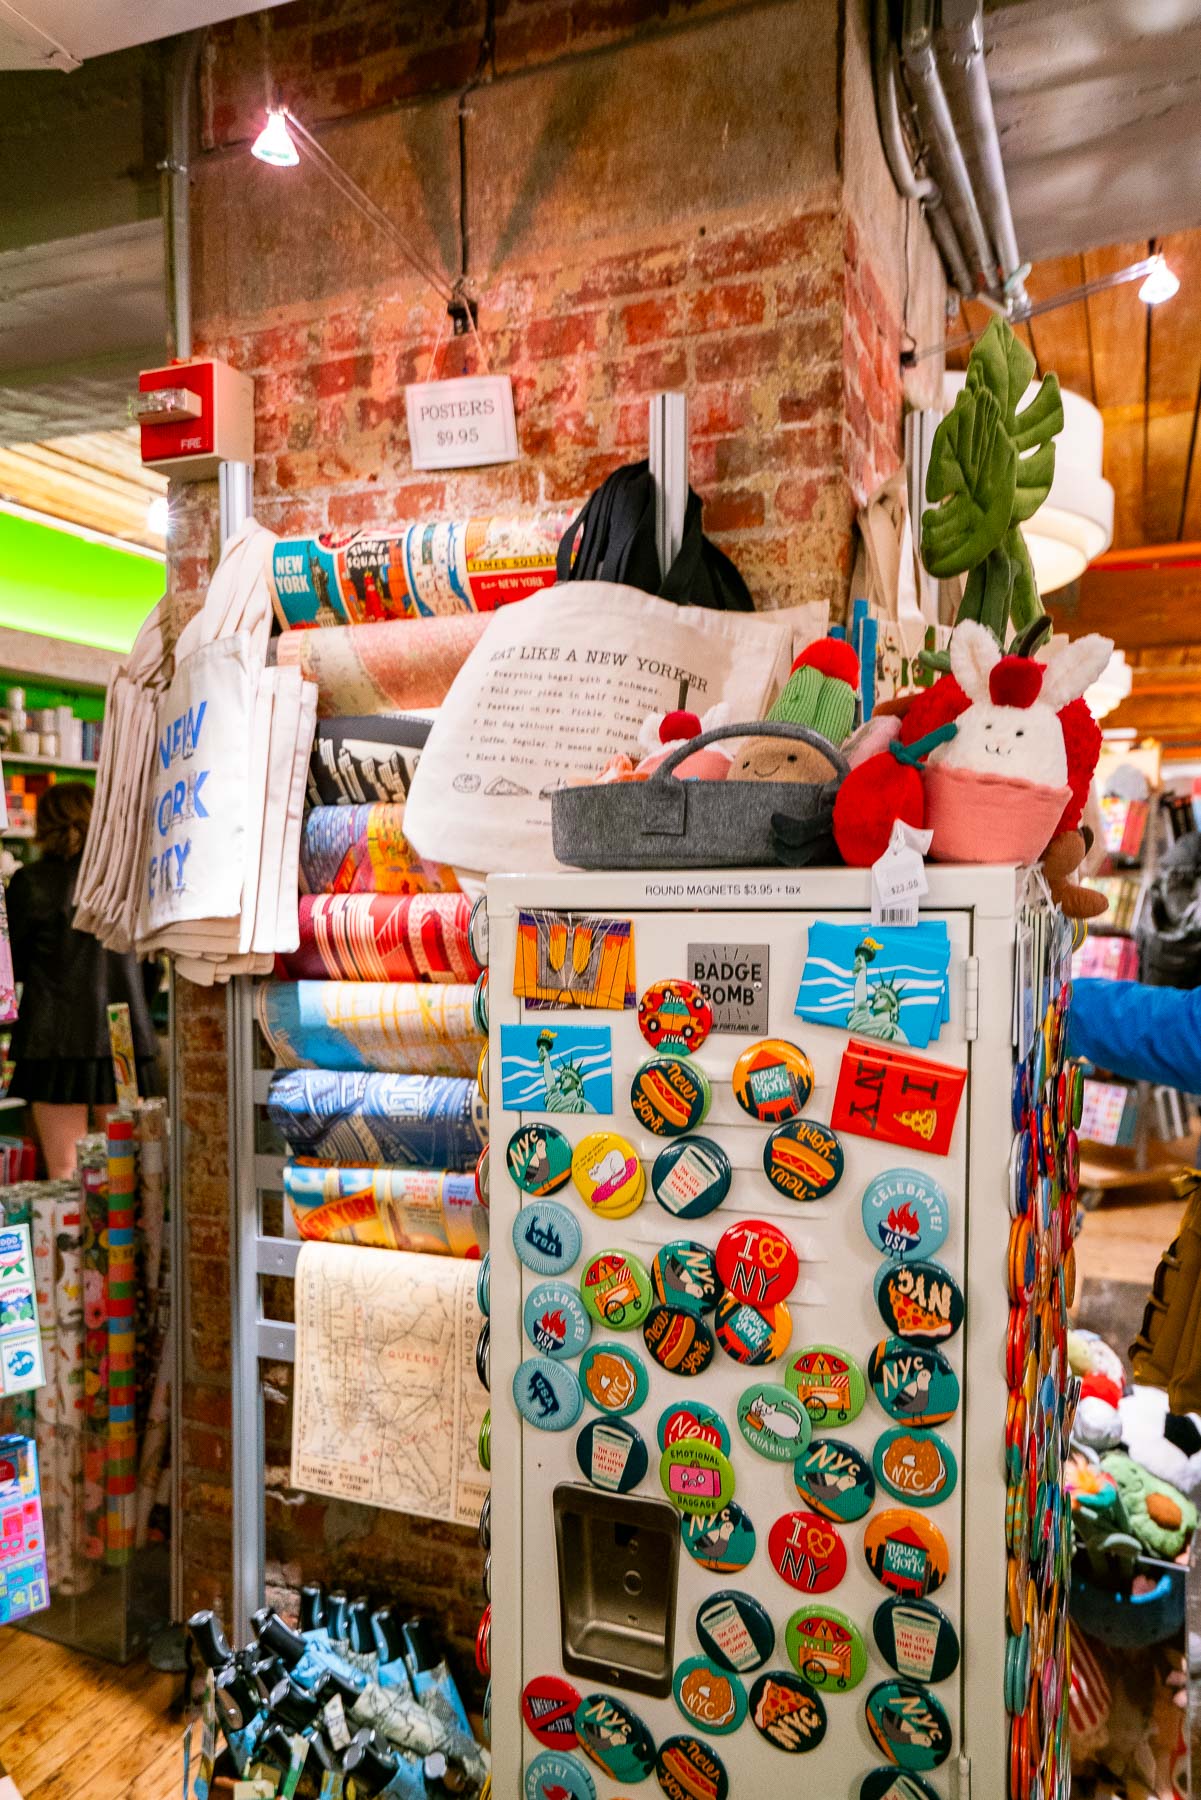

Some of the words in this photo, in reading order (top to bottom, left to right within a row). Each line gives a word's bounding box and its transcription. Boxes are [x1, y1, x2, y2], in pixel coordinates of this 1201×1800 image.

[420, 399, 495, 421] POSTERS
[180, 437, 202, 449] FIRE
[437, 427, 479, 446] $9.95
[275, 555, 303, 575] NEW
[472, 559, 507, 571] TIMES
[276, 574, 310, 595] YORK
[498, 578, 519, 590] NEW
[520, 575, 544, 588] YORK
[490, 646, 516, 662] EAT
[520, 646, 560, 661] LIKE
[566, 649, 577, 662] A
[585, 649, 628, 667] NEW
[637, 656, 708, 693] YORKER
[493, 670, 542, 681] Everything
[548, 671, 574, 682] bagel
[580, 674, 601, 683] with
[513, 688, 533, 697] your
[538, 691, 563, 699] pizza
[569, 691, 579, 699] in
[585, 692, 606, 701] half
[613, 695, 630, 704] the
[638, 699, 659, 714] long
[483, 719, 497, 727] Hot
[502, 720, 515, 730] dog
[520, 721, 554, 732] without
[475, 752, 496, 761] Black
[567, 743, 592, 753] means
[596, 745, 618, 754] milk
[645, 884, 684, 897] ROUND
[686, 884, 742, 897] MAGNETS
[743, 883, 774, 898] $3.95
[785, 884, 801, 896] tax
[694, 962, 762, 982] BADGE
[701, 983, 755, 1006] BOMB
[668, 1063, 698, 1102] new
[752, 1067, 780, 1087] new
[756, 1076, 790, 1099] york
[901, 1074, 939, 1101] I
[849, 1060, 887, 1131] NY
[632, 1093, 664, 1134] york
[797, 1124, 837, 1159] york
[671, 1168, 685, 1182] THAT
[683, 1180, 698, 1197] NEVER
[679, 1164, 690, 1176] THE
[688, 1173, 701, 1188] CITY
[771, 1167, 807, 1200] new
[871, 1182, 943, 1232] CELEBRATE!
[532, 1231, 557, 1252] USA
[738, 1229, 760, 1261] I
[885, 1231, 907, 1251] USA
[730, 1260, 781, 1302] NY
[898, 1268, 952, 1320] NYC
[464, 1286, 475, 1367] HUDSON
[533, 1291, 585, 1341] CELEBRATE!
[645, 1310, 669, 1342] new
[738, 1305, 767, 1330] new
[536, 1330, 555, 1350] USA
[735, 1319, 765, 1346] york
[388, 1350, 440, 1367] QUEENS
[682, 1340, 710, 1375] york
[800, 1359, 842, 1372] NYC
[535, 1378, 554, 1406] USA
[607, 1375, 629, 1406] NYC
[597, 1446, 609, 1456] THE
[609, 1450, 623, 1460] CITY
[743, 1428, 791, 1458] AQUARIUS
[593, 1452, 607, 1462] THAT
[607, 1459, 625, 1470] NEVER
[670, 1449, 721, 1467] EMOTIONAL
[892, 1466, 925, 1490] NYC
[678, 1495, 717, 1510] BAGGAGE
[786, 1517, 808, 1549] I
[886, 1542, 919, 1558] new
[779, 1546, 829, 1590] NY
[892, 1552, 925, 1575] york
[727, 1623, 740, 1634] CITY
[804, 1621, 845, 1640] NYC
[901, 1631, 913, 1641] THE
[915, 1634, 930, 1645] CITY
[719, 1638, 732, 1648] THAT
[896, 1640, 912, 1650] THAT
[913, 1644, 934, 1655] NEVER
[531, 1697, 559, 1719] AMERICA
[687, 1692, 716, 1719] NYC
[767, 1707, 822, 1750] NYC
[687, 1741, 720, 1779] new
